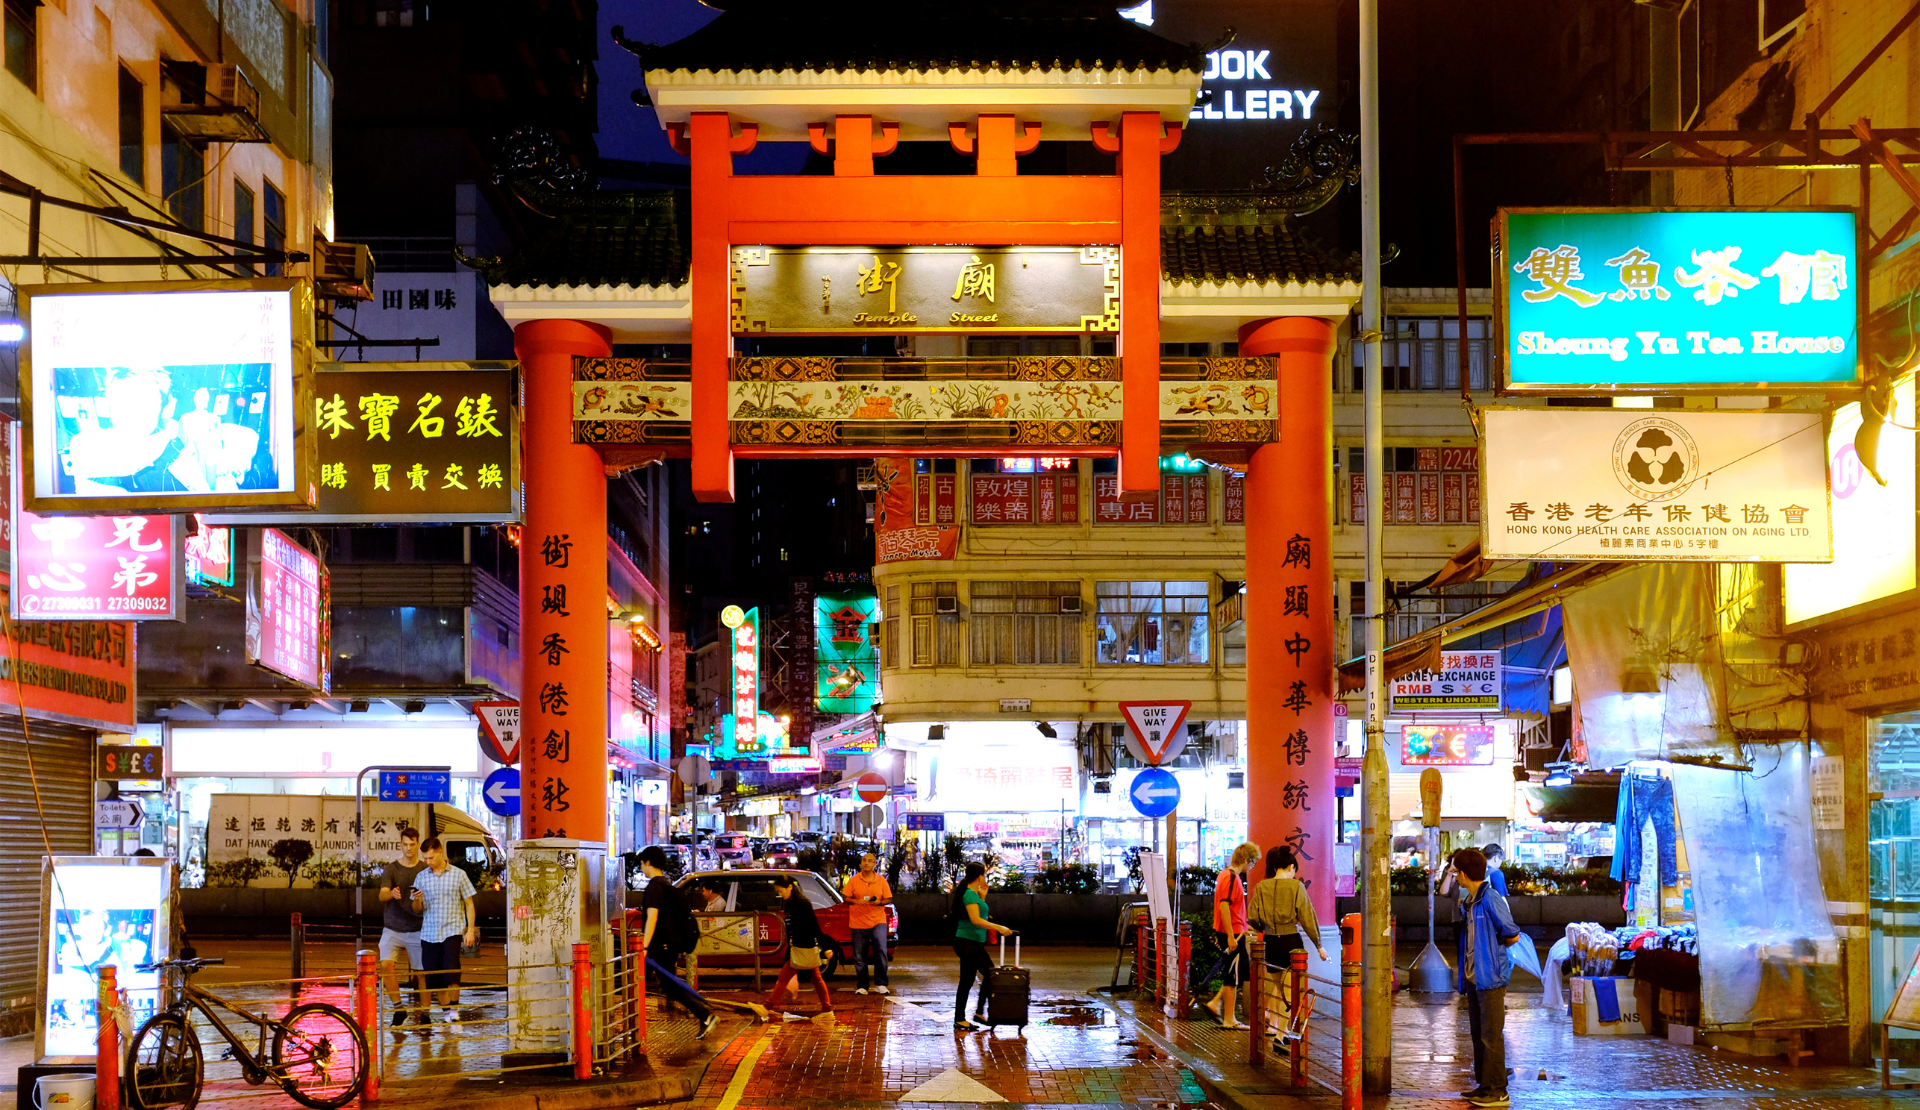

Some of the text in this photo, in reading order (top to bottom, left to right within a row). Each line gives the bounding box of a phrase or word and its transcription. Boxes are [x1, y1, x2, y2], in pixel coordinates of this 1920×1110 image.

[1513, 244, 1847, 308] 雙魚茶館
[853, 311, 998, 325] Temple Street
[1517, 330, 1846, 361] Sheung Yu Tea House
[316, 392, 503, 441] 珠寶名錶
[975, 479, 1030, 498] 敦煌
[919, 477, 929, 521] 招生
[1166, 477, 1182, 522] 手工精製
[1189, 476, 1205, 522] 保養修理
[975, 502, 1030, 520] 樂器
[1505, 502, 1810, 525] 香港老年保健協會
[1506, 525, 1537, 535] HONG
[1542, 525, 1572, 535] KONG
[1577, 525, 1618, 536] HEALTH
[1622, 526, 1650, 536] CARE
[1655, 526, 1727, 536] ASSOCIATION
[1732, 527, 1748, 536] ON
[1752, 527, 1786, 537] AGING
[107, 597, 167, 611] 27309032
[1438, 671, 1496, 682] EXCHANGE
[539, 533, 573, 838] 街現香港創新
[1396, 684, 1432, 694] RMB
[495, 709, 519, 717] GIVE
[1143, 708, 1167, 717] GIVE
[496, 718, 519, 726] WAY
[1144, 718, 1167, 726] WAY
[502, 731, 514, 741] 讓
[1149, 730, 1161, 742] 讓
[100, 804, 126, 812] Toilets
[225, 838, 243, 848] DAT
[248, 838, 274, 849] HANG
